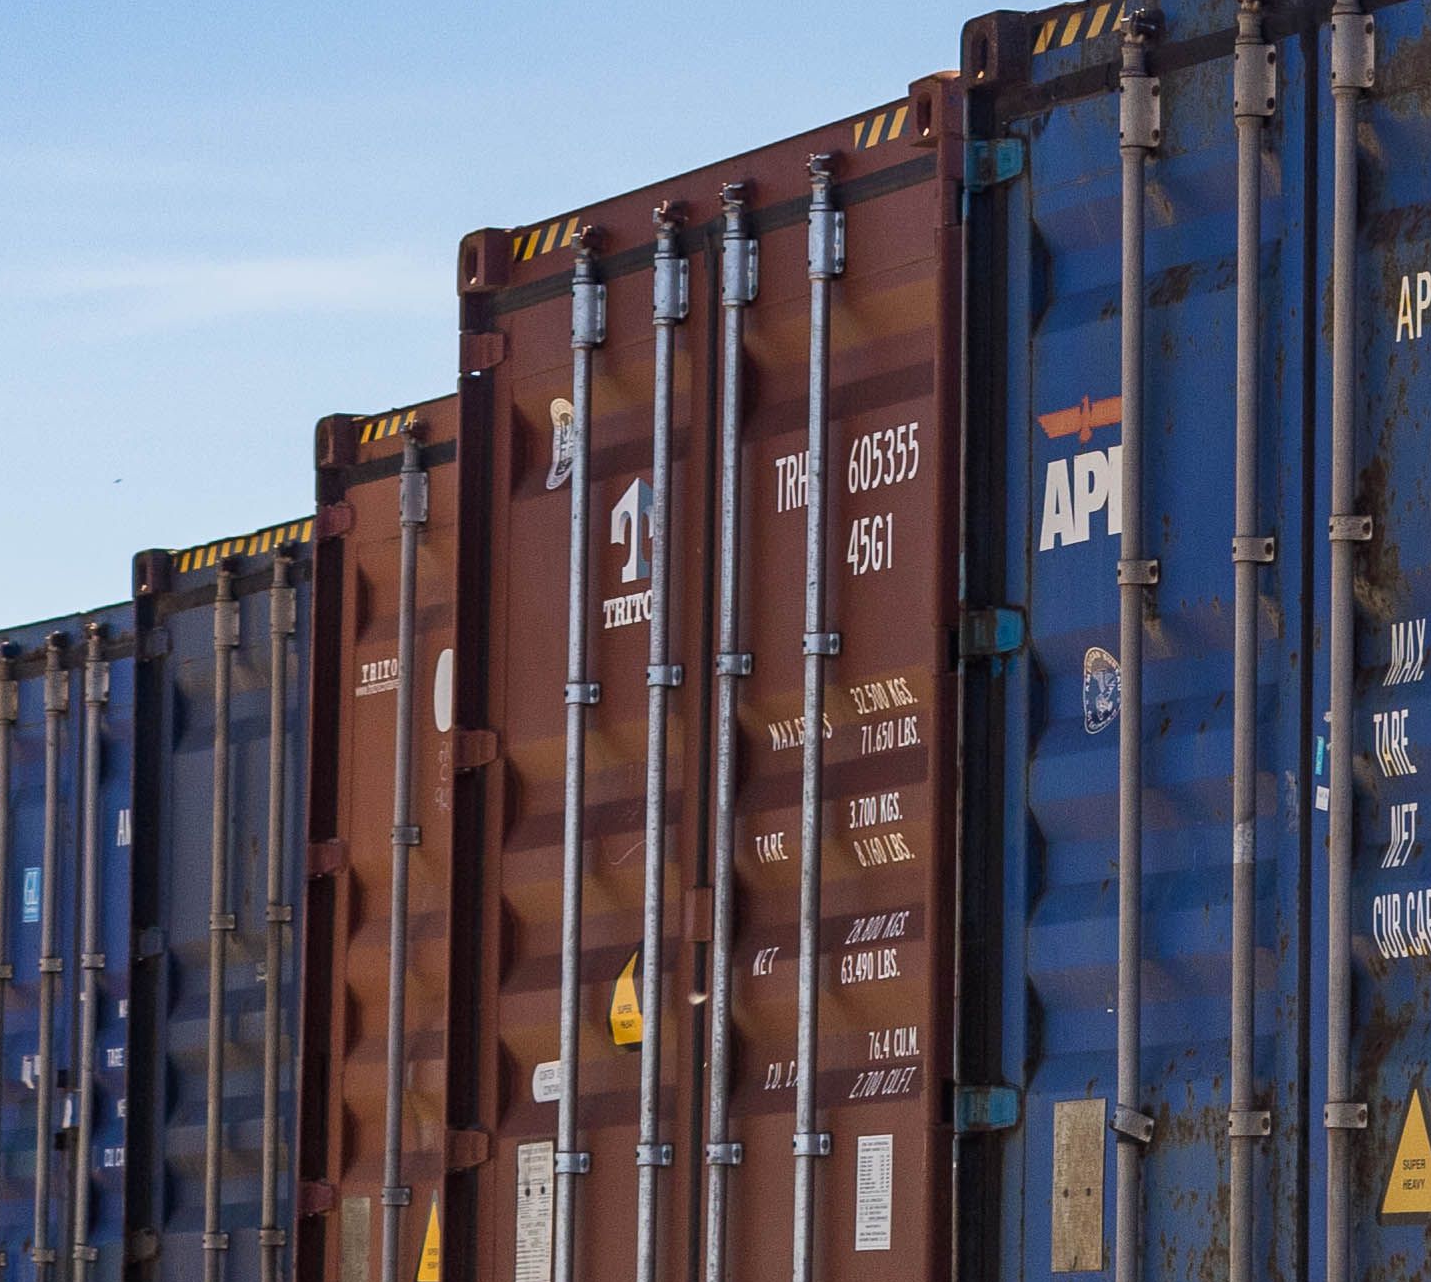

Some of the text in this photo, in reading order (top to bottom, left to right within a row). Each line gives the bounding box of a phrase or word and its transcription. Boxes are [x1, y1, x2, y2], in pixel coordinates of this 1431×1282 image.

[775, 421, 920, 514] TRH 605355
[846, 512, 894, 576] 45G1
[603, 589, 653, 630] TRITO
[361, 657, 398, 684] TRITO
[1373, 709, 1417, 777] TARE
[755, 831, 789, 864] TARE
[1381, 802, 1418, 869] NET
[752, 946, 781, 976] NET
